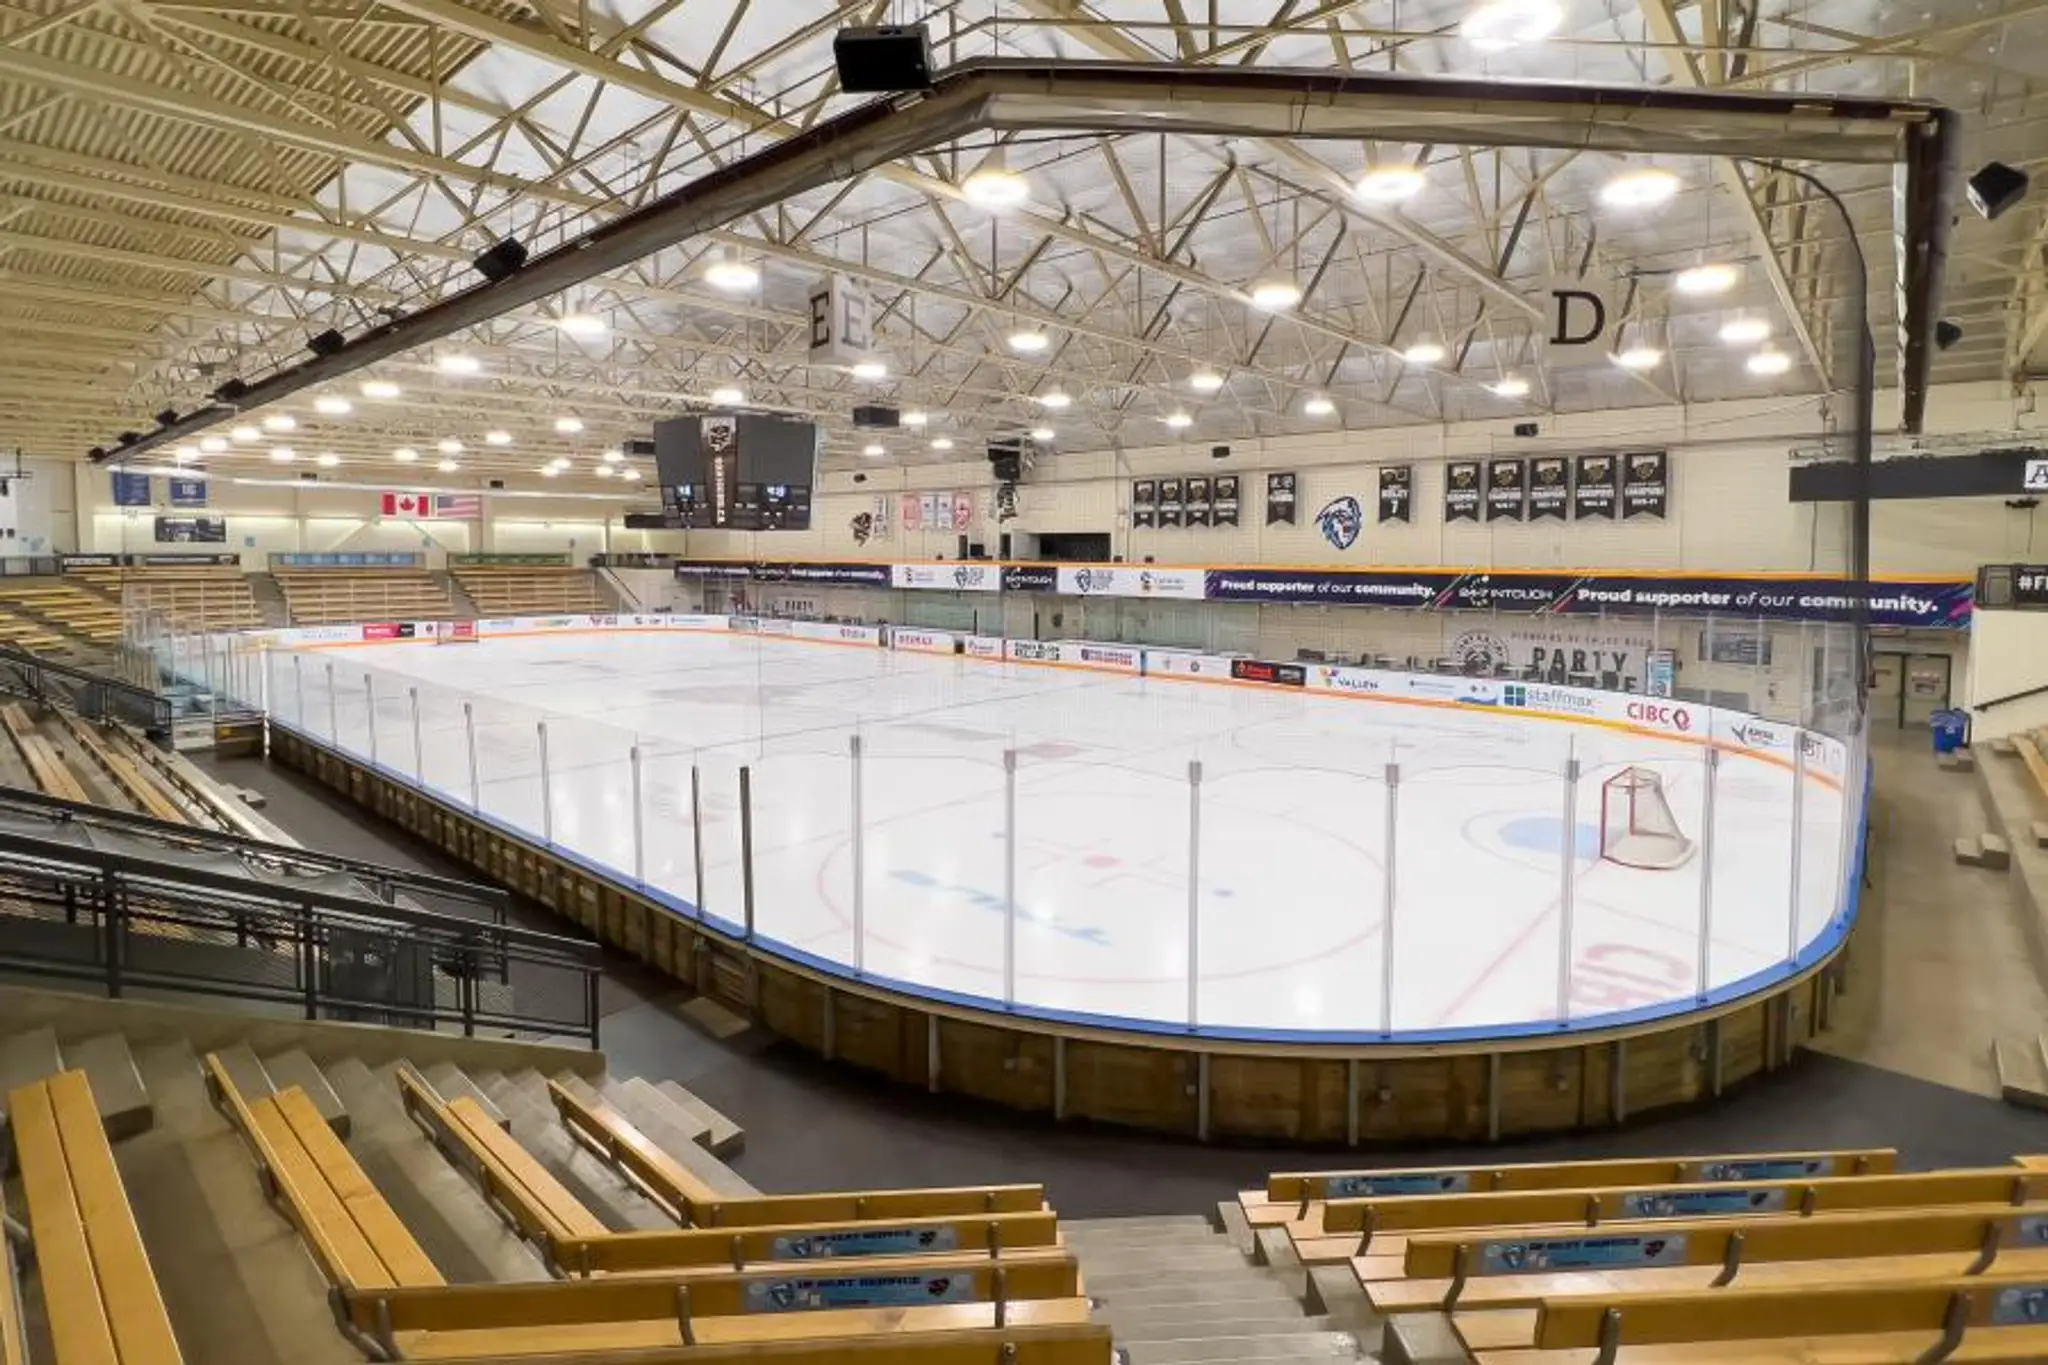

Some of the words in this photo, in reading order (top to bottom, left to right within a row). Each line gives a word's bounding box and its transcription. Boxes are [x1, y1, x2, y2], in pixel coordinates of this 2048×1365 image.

[810, 291, 829, 349] E
[841, 291, 867, 350] E
[1550, 291, 1605, 345] D
[1221, 580, 1255, 590] Proud
[1257, 582, 1314, 593] supporter
[1318, 582, 1330, 593] of
[1331, 584, 1352, 593] our
[1354, 582, 1435, 599] community.
[1578, 589, 1631, 602] Proud
[1636, 592, 1730, 606] supporter
[1736, 592, 1757, 606] of
[1759, 596, 1794, 606] our
[1533, 647, 1628, 672] PARTY
[1627, 702, 1670, 724] CIBC
